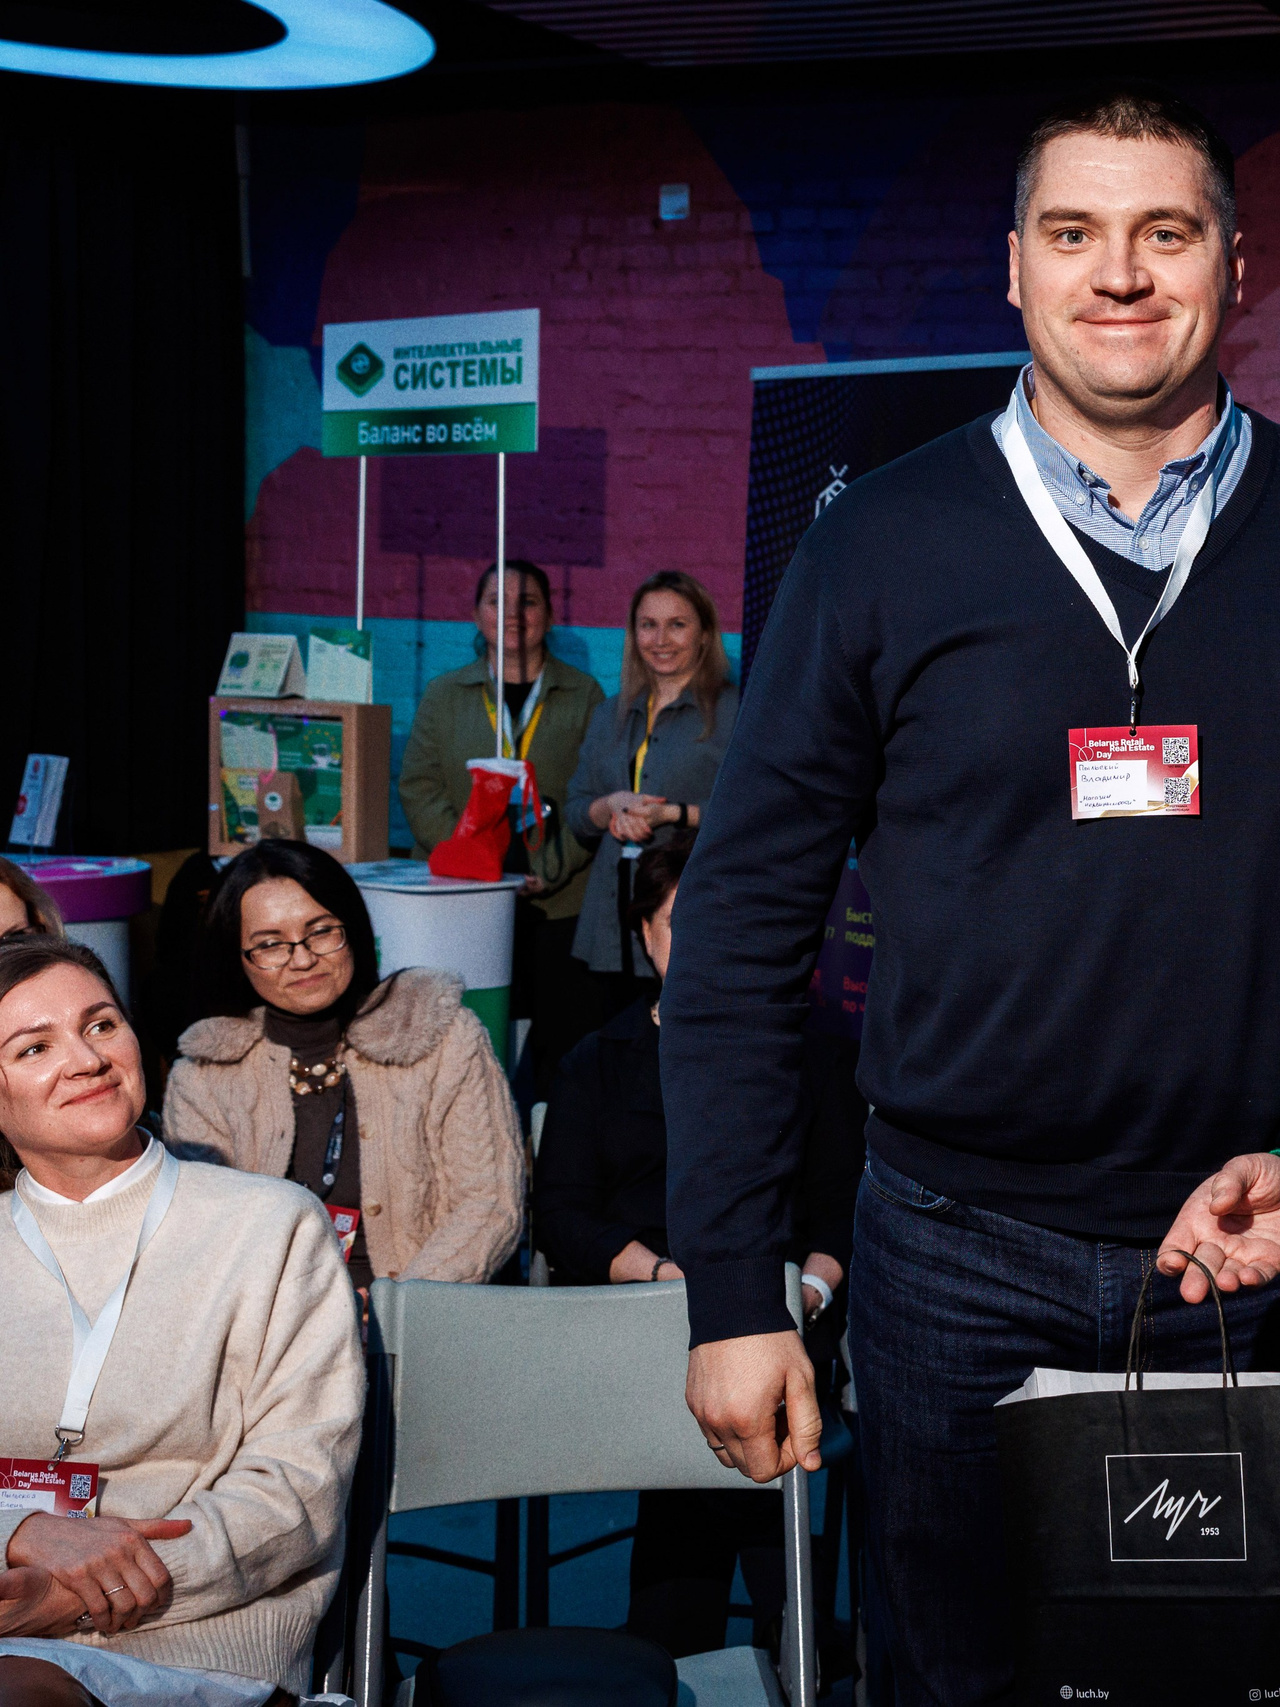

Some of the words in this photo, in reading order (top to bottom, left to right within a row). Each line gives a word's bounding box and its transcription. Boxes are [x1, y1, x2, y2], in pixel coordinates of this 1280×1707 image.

[393, 338, 522, 360] ИНТЕЛЛЕКТУАЛЬНЫЕ
[393, 356, 523, 391] СИСТЕМЫ
[358, 421, 421, 445] Баланс
[426, 424, 447, 443] во
[452, 417, 497, 443] всём
[1089, 739, 1119, 748] Belarus
[1121, 738, 1144, 746] Retail
[1110, 744, 1127, 752] Real
[1129, 744, 1155, 752] Estate
[1096, 751, 1112, 759] Day
[1081, 773, 1131, 782] Владимир
[13, 1469, 38, 1478] Belarus
[40, 1471, 58, 1479] Retail
[18, 1480, 31, 1489] Day
[30, 1475, 44, 1484] Real
[45, 1477, 65, 1485] Estate
[1200, 1527, 1220, 1536] 1953
[1076, 1688, 1110, 1700] luch.by
